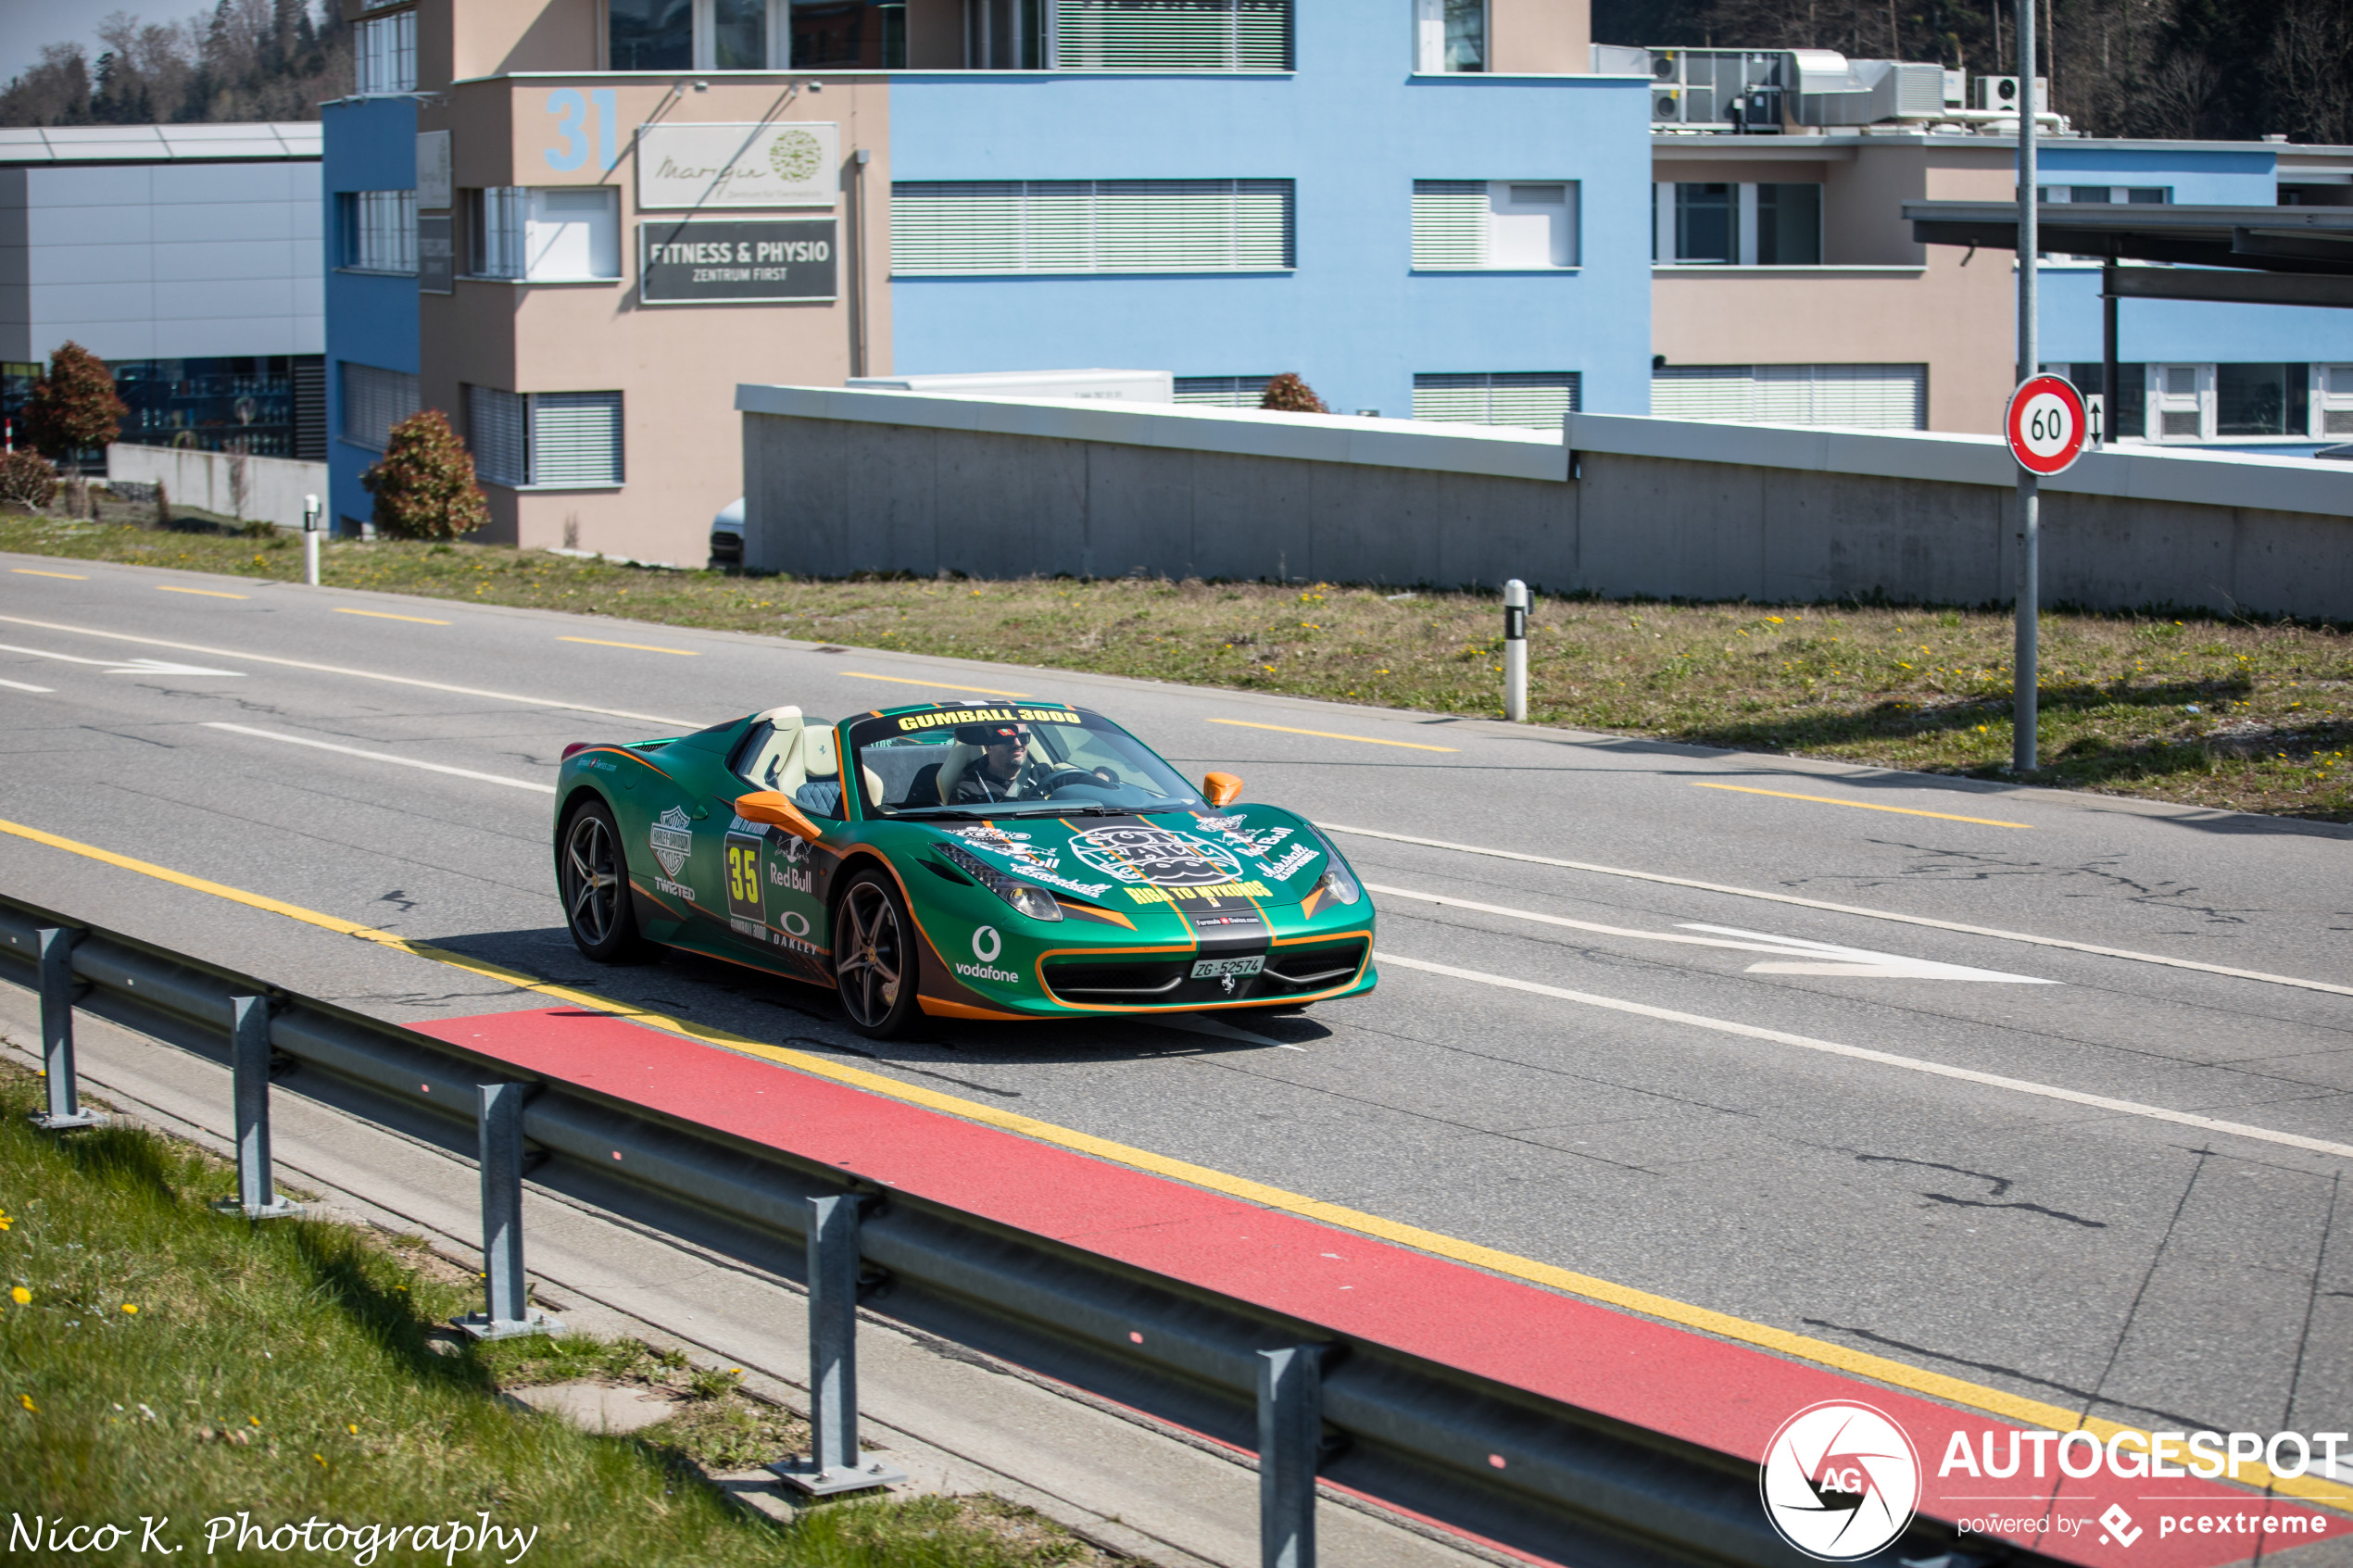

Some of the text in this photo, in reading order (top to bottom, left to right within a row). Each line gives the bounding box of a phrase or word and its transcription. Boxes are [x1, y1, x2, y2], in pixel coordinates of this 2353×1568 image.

[543, 88, 616, 172] 31
[650, 241, 829, 265] FITNESS & PHYSIO
[692, 267, 787, 282] ZENTRUM FIRST
[2032, 408, 2060, 441] 60
[898, 709, 1081, 732] GUMBALL 3000
[1233, 827, 1294, 858] Red Bull
[1013, 855, 1060, 869] Bull
[1255, 843, 1309, 877] Marshall
[729, 847, 759, 904] 35
[771, 862, 812, 894] Red Bull
[655, 876, 695, 901] TWISTED
[1123, 880, 1274, 905] RIGA TO MYKONOS
[774, 934, 817, 955] OAKLEY
[955, 962, 1019, 984] vodafone
